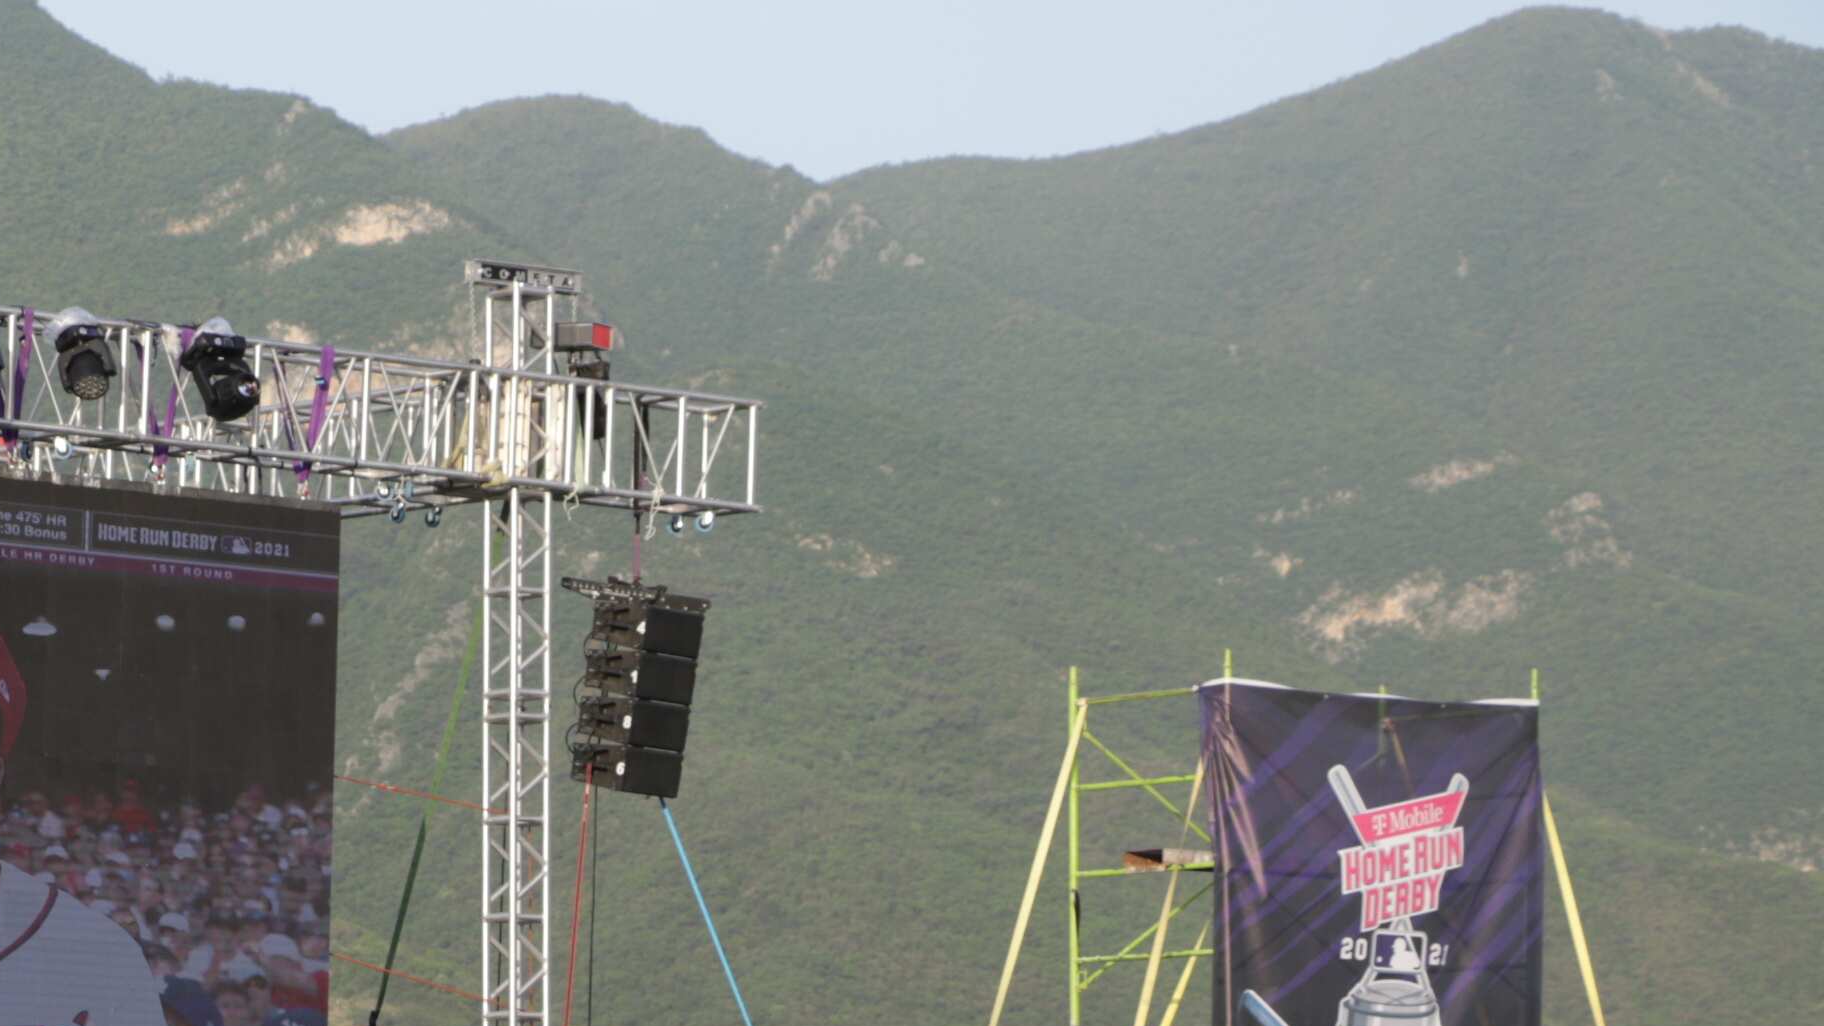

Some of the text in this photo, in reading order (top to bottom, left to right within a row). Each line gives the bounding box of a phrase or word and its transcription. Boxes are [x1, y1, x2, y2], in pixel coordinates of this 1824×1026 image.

[483, 266, 570, 286] COMETA
[46, 513, 68, 527] HR
[23, 526, 68, 540] Bonus
[97, 522, 290, 558] HOME RUN DERBY 2021
[23, 549, 43, 562] HR
[49, 553, 96, 567] DERBY
[151, 563, 233, 581] 1ST ROUND
[1371, 803, 1444, 836] T Mobile
[1345, 832, 1462, 890] HOME RUN
[1364, 873, 1440, 930] DERBY
[1339, 937, 1449, 966] 20 21
